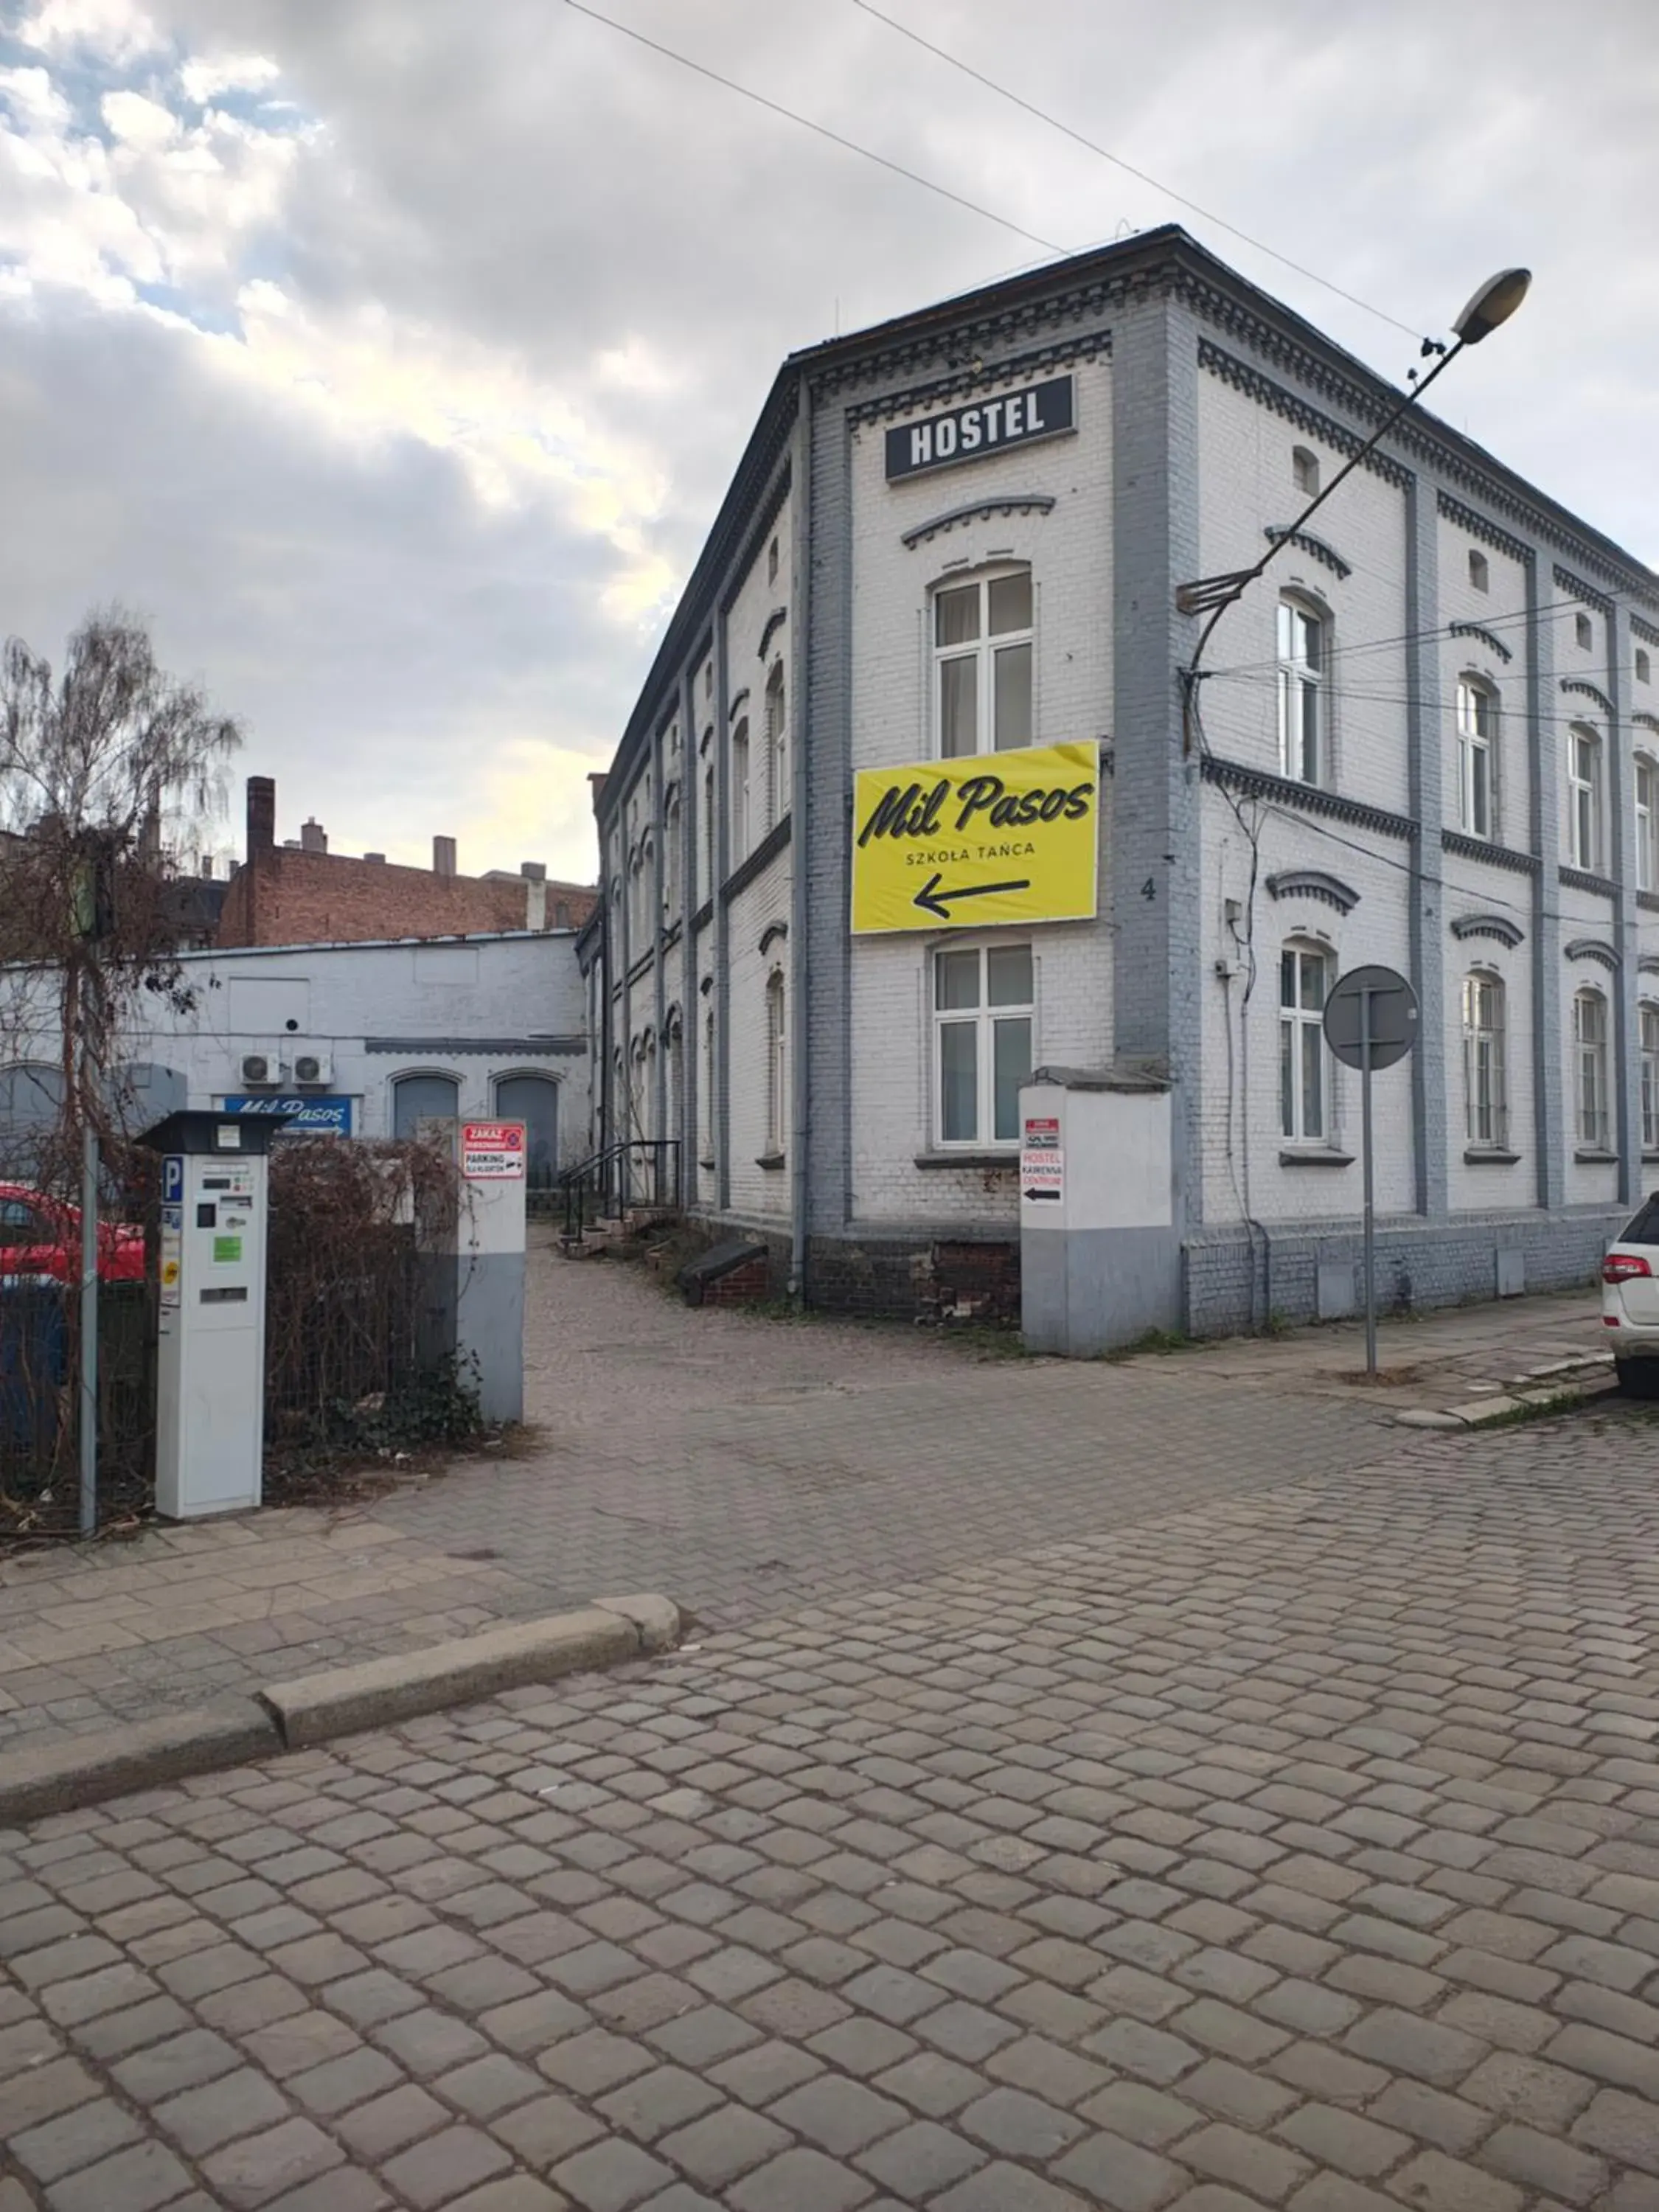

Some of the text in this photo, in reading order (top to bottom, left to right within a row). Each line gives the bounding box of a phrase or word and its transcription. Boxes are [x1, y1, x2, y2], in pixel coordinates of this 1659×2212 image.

[911, 392, 1045, 465] HOSTEL
[857, 775, 1096, 849] Mil Pasos
[905, 842, 1035, 866] SZKOŁA TAŃCA
[1141, 877, 1157, 901] 4
[282, 1099, 345, 1121] Pasos
[466, 1153, 504, 1163] PARKING
[1023, 1153, 1061, 1164] HOSTEL
[166, 1161, 180, 1198] P
